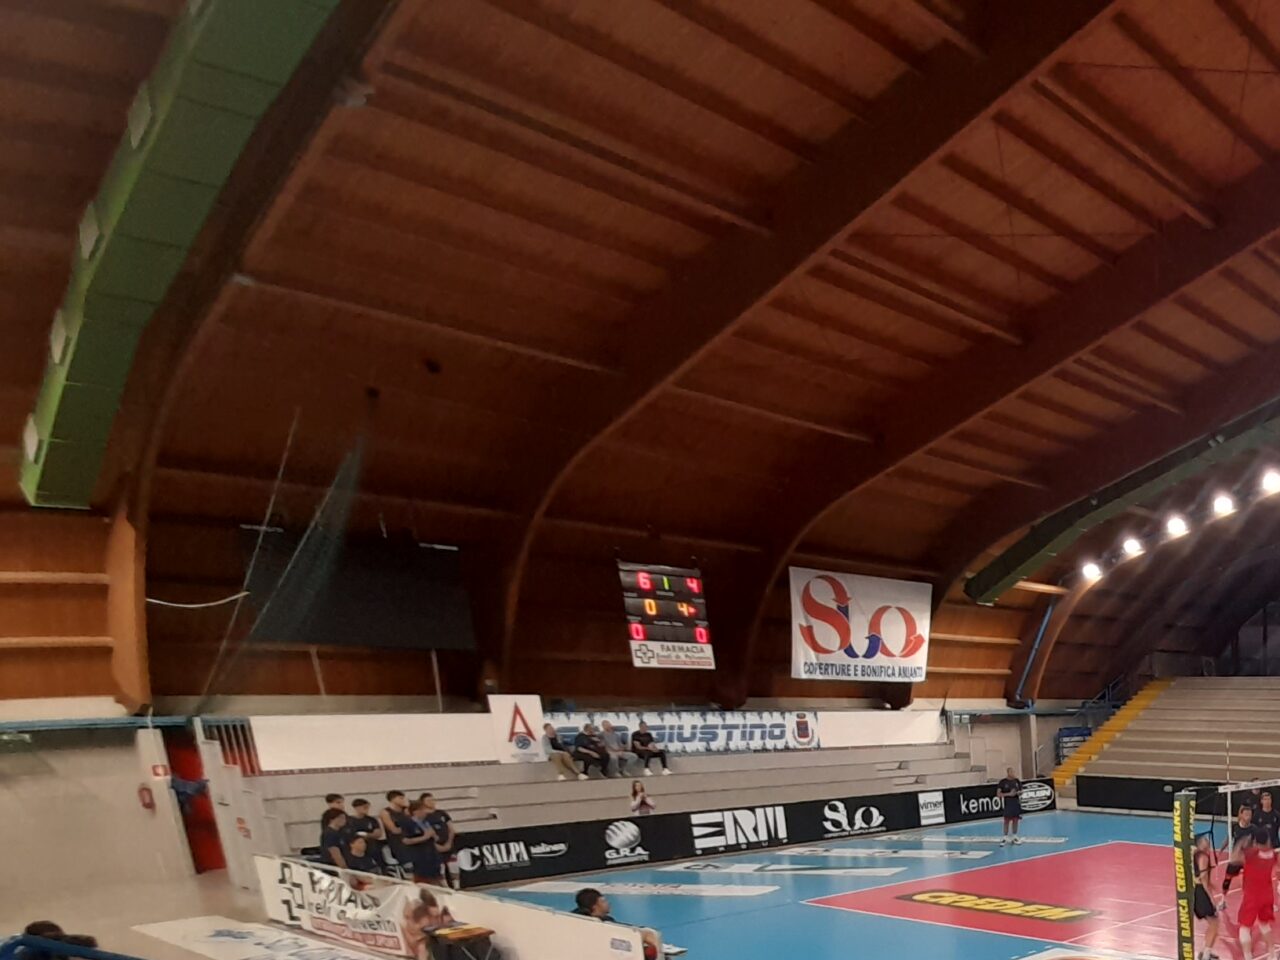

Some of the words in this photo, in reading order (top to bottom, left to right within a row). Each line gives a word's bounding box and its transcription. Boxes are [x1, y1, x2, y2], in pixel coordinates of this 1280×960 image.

[637, 571, 651, 589] 6
[686, 577, 700, 593] 4
[644, 598, 657, 615] 0
[631, 623, 644, 639] 0
[695, 627, 707, 643] 0
[960, 794, 1006, 814] kemo
[911, 892, 1092, 920] CREDEM
